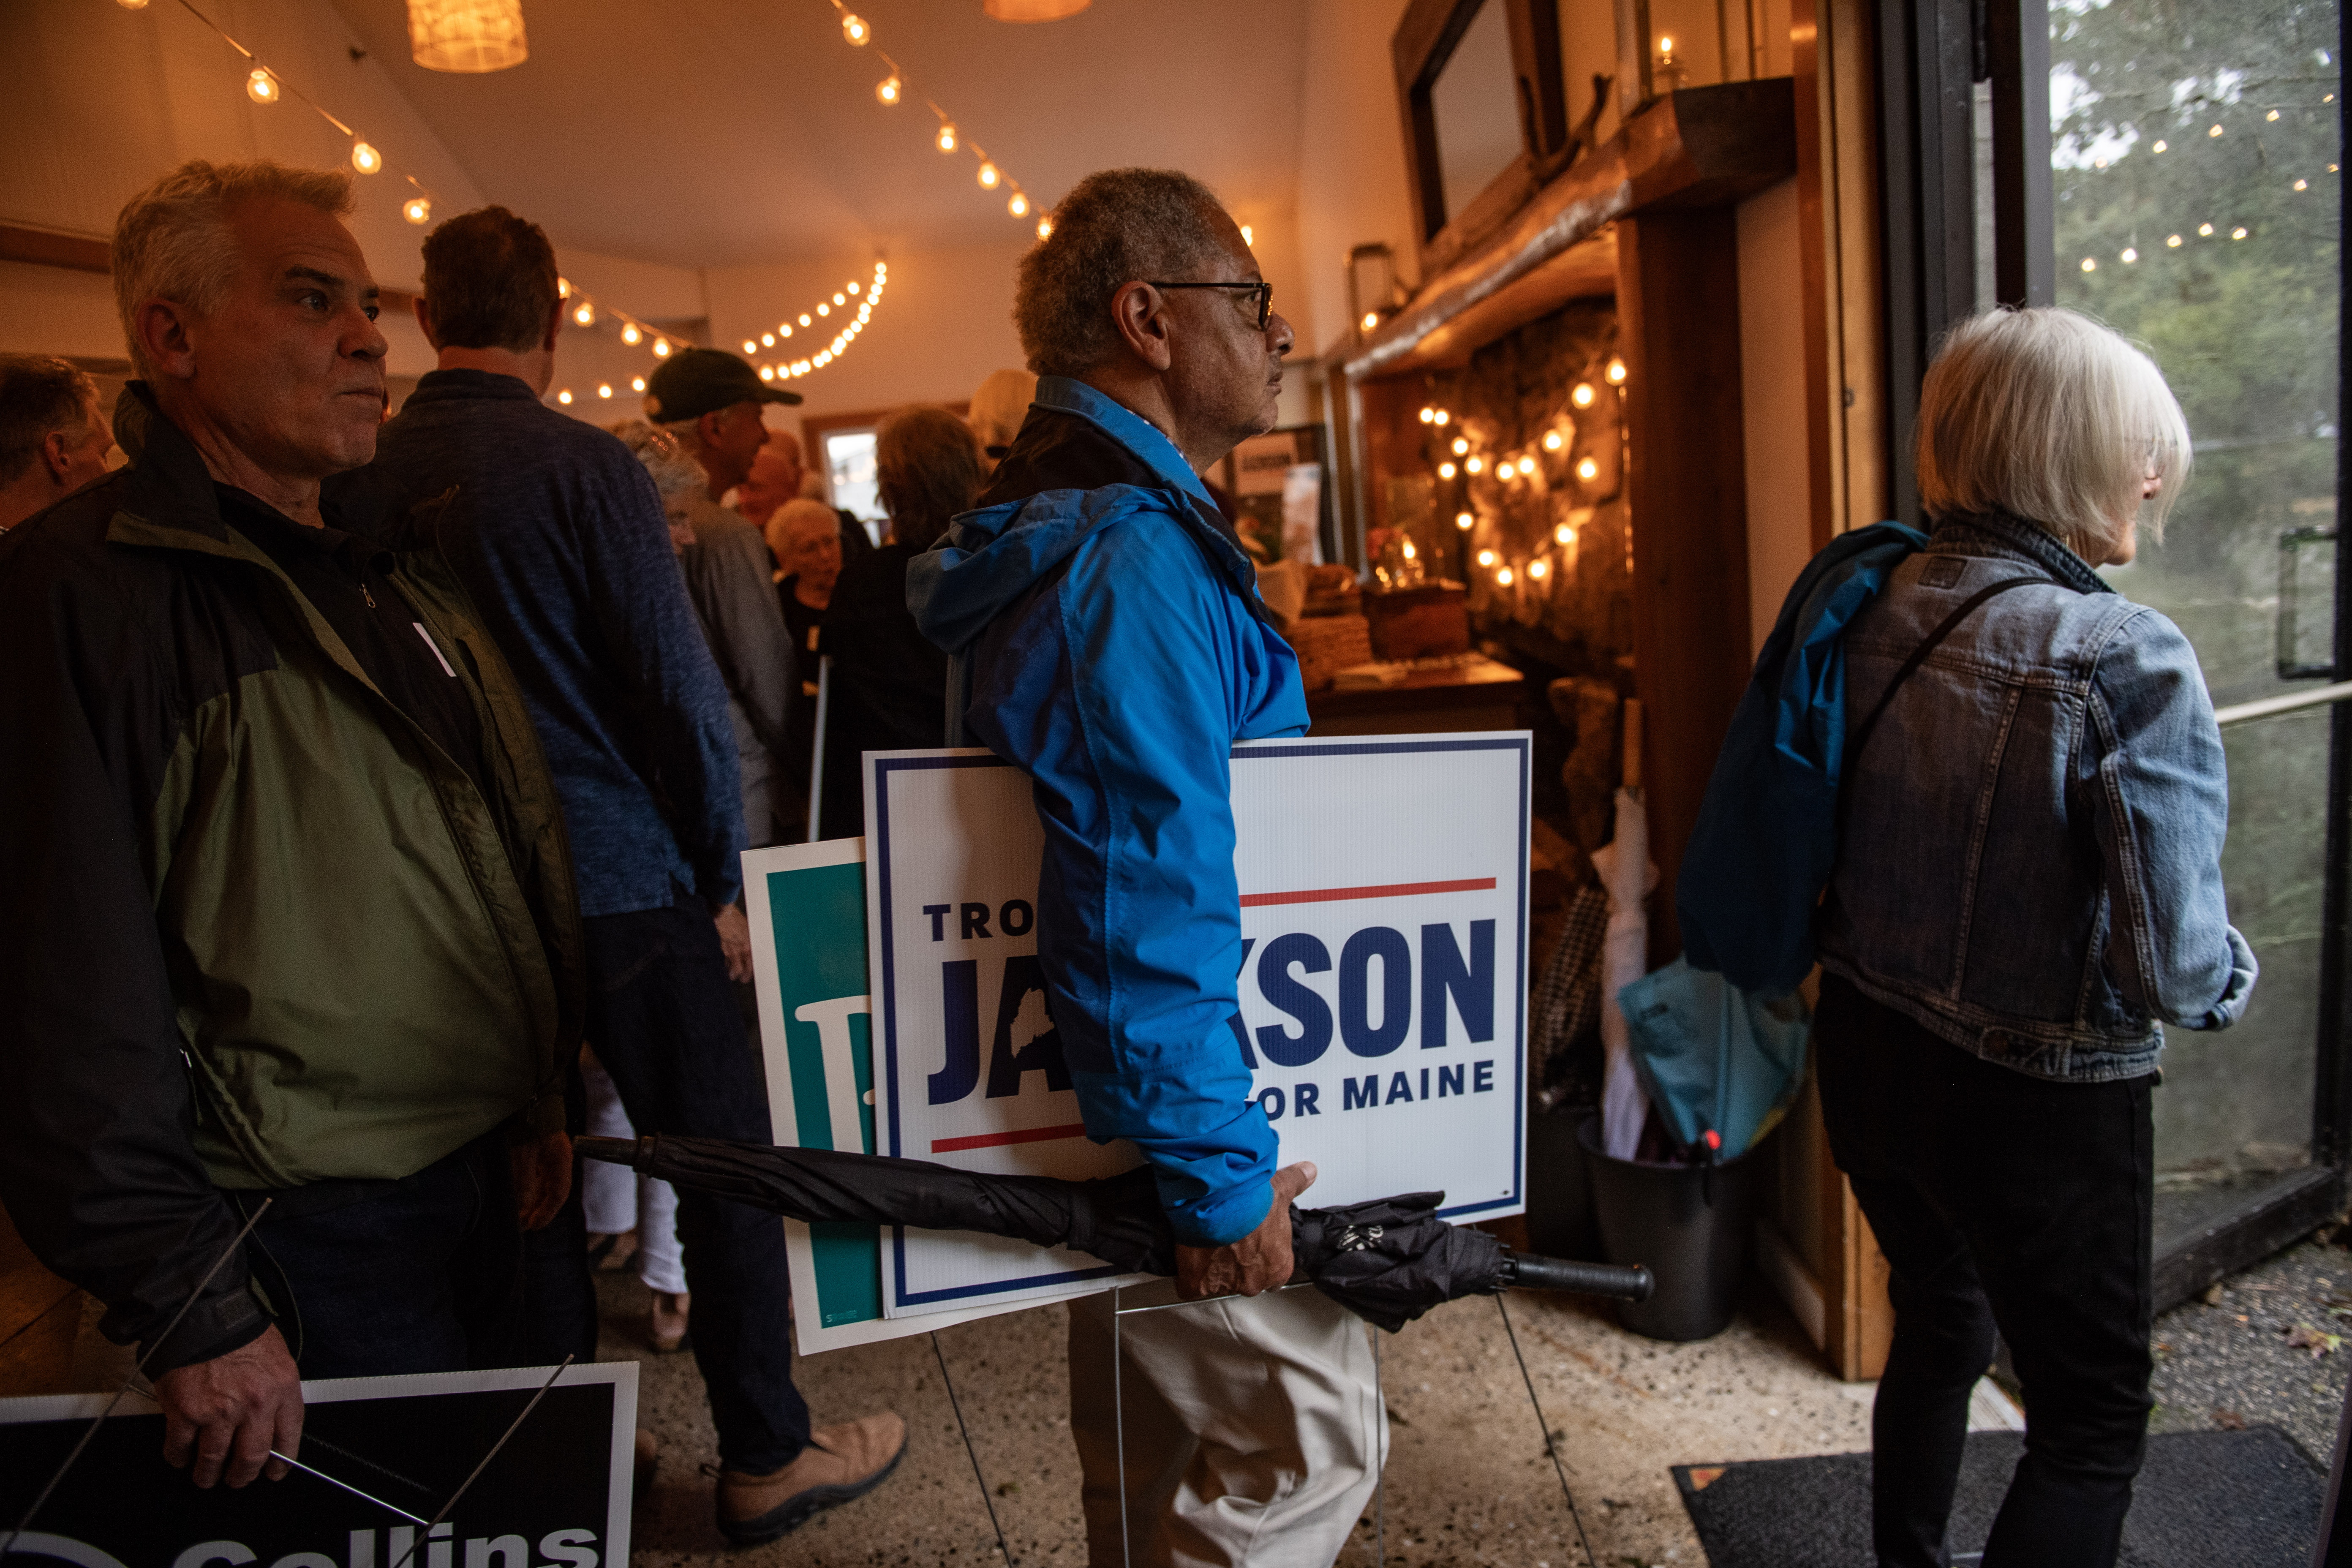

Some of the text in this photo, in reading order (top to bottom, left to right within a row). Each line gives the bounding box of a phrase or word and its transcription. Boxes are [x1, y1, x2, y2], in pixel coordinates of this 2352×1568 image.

[923, 899, 1034, 942] TRO
[928, 918, 1496, 1106] JASON
[1257, 1060, 1494, 1122] OR MAINE
[172, 1522, 599, 1568] llins
